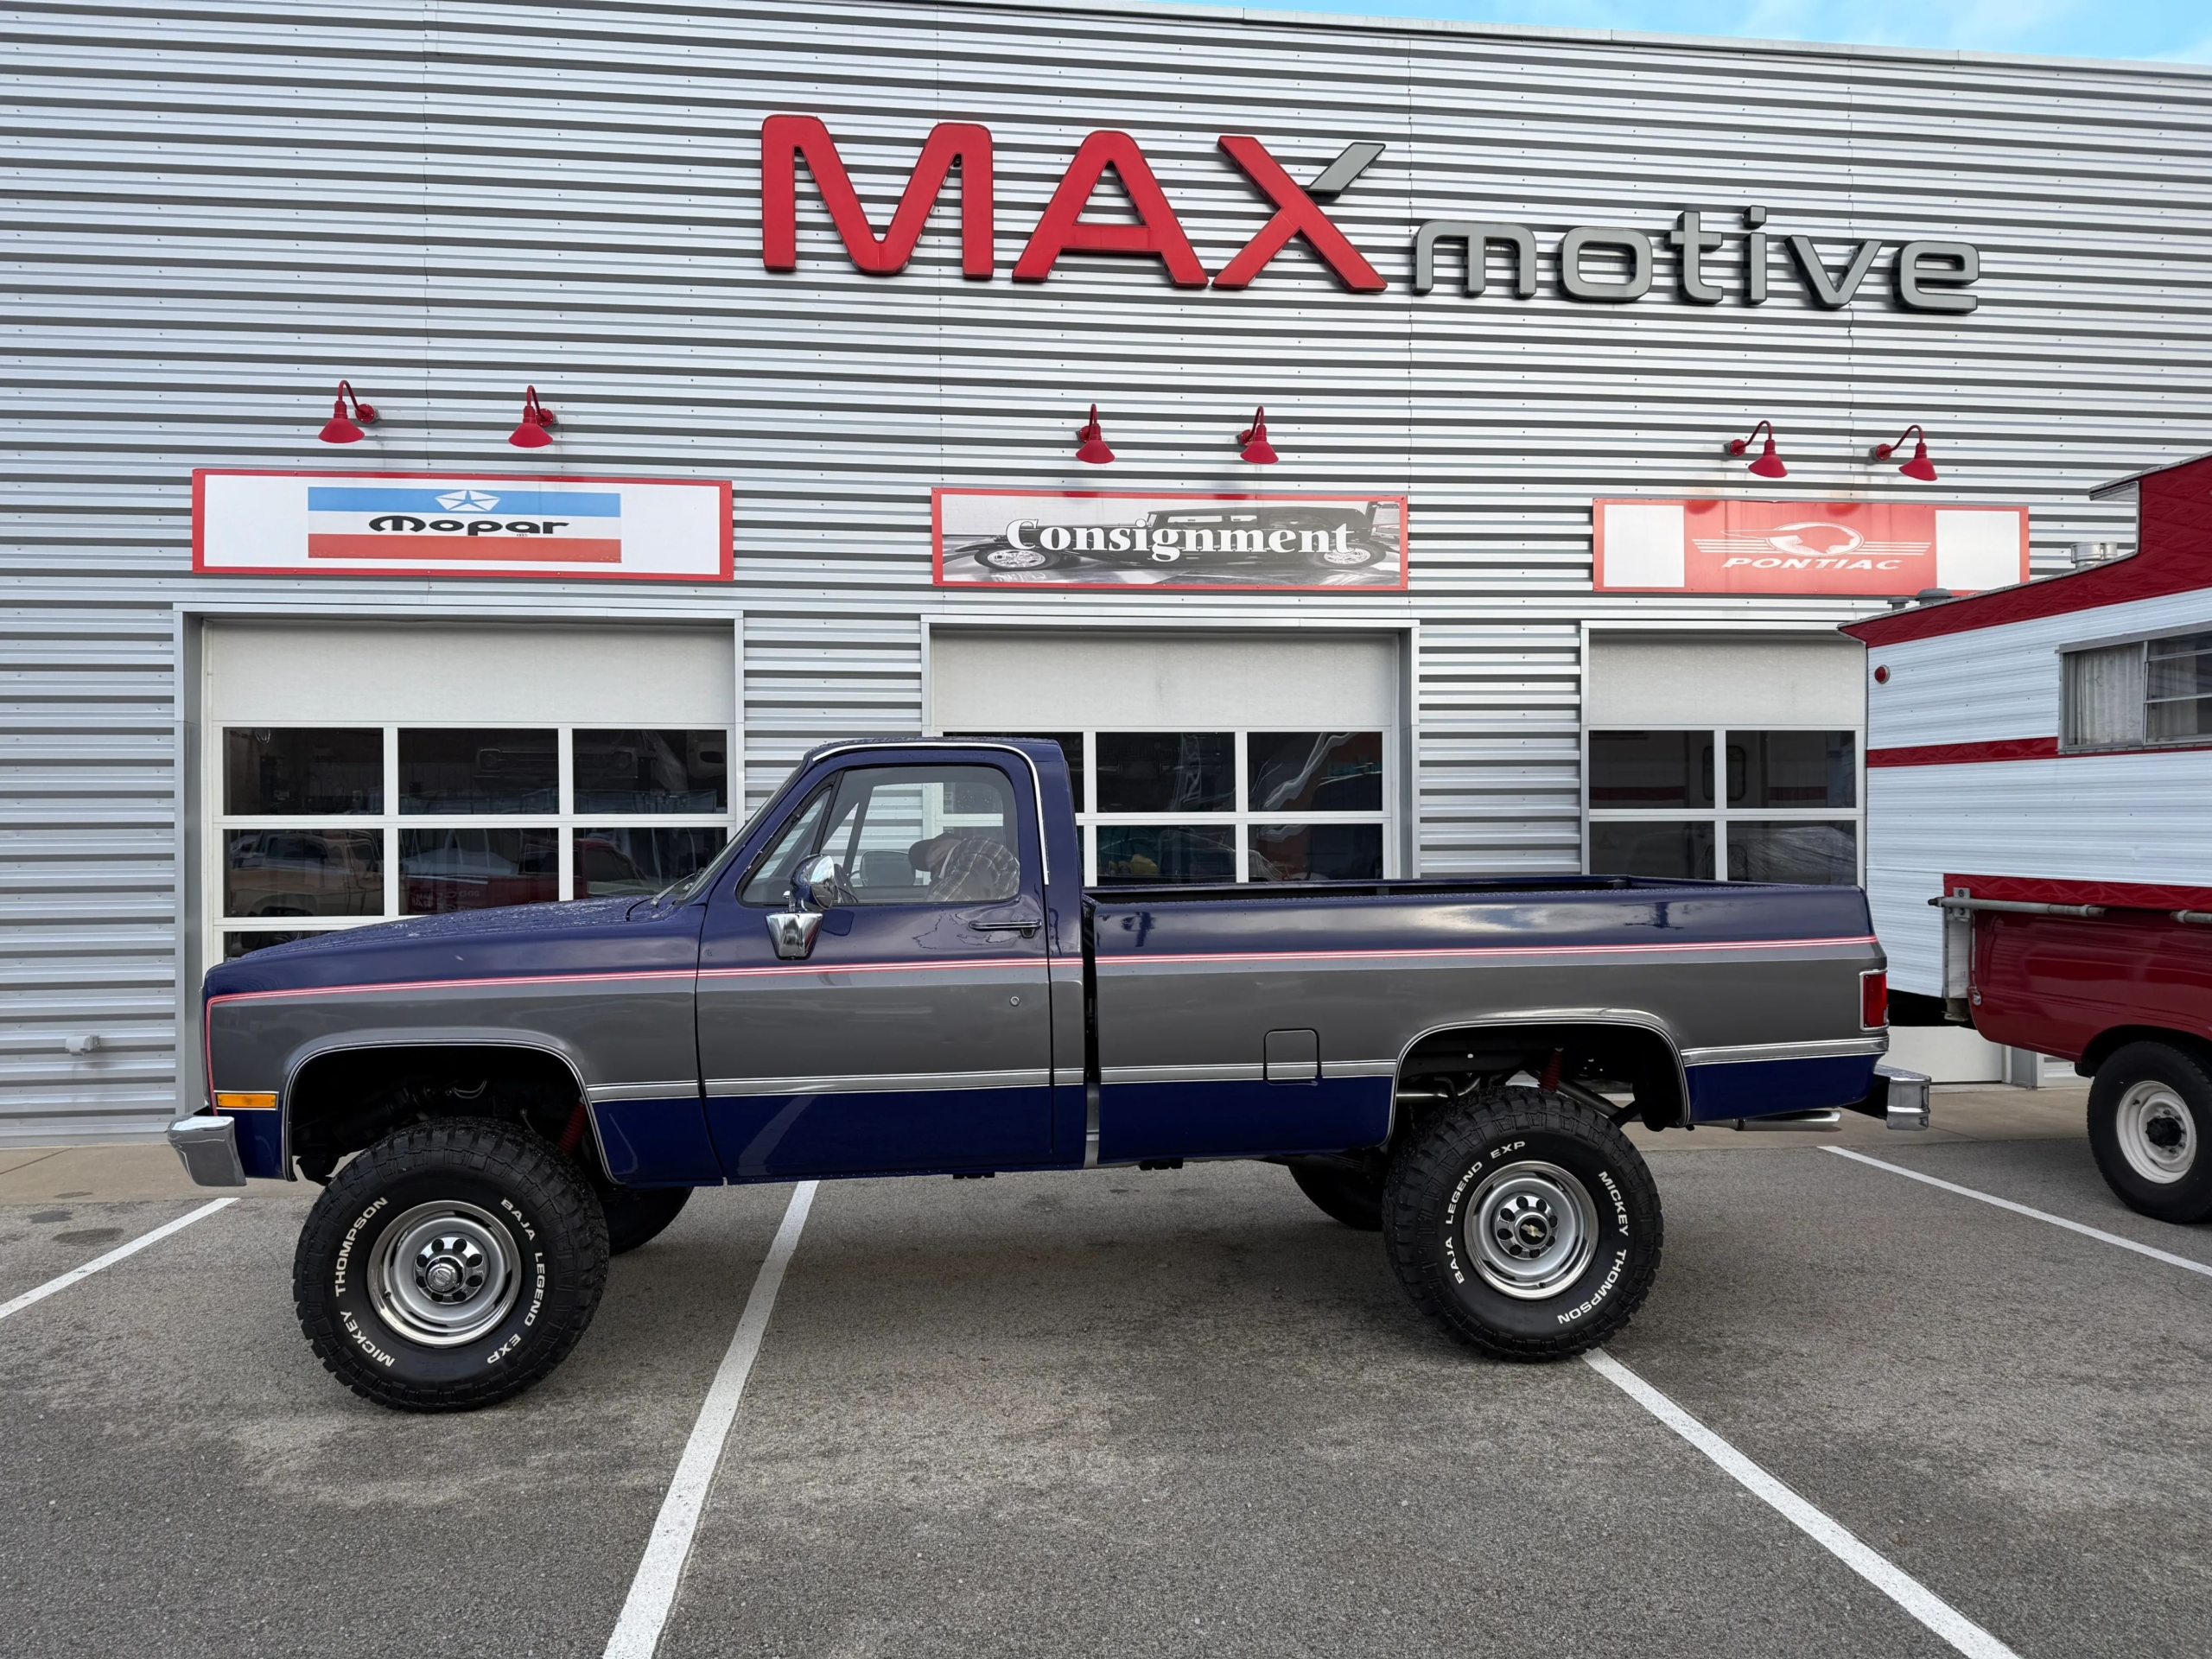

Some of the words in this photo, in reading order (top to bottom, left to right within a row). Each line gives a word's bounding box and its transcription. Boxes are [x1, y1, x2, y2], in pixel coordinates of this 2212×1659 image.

[761, 114, 1388, 294] MAX
[1412, 205, 1980, 314] motive
[1006, 518, 1356, 563] Consignment
[1721, 557, 1904, 570] PONTIAC
[1490, 1141, 1526, 1159] EXP
[500, 1198, 536, 1241] BAJA
[1445, 1161, 1483, 1224] LEGEND
[1599, 1171, 1629, 1236] MICKEY
[334, 1197, 388, 1297] THOMPSON
[1445, 1236, 1465, 1284] BAJA
[524, 1252, 545, 1326] LEGEND
[1556, 1249, 1627, 1325] THOMPSON
[340, 1310, 396, 1367] MICKEY
[486, 1333, 522, 1364] EXP
